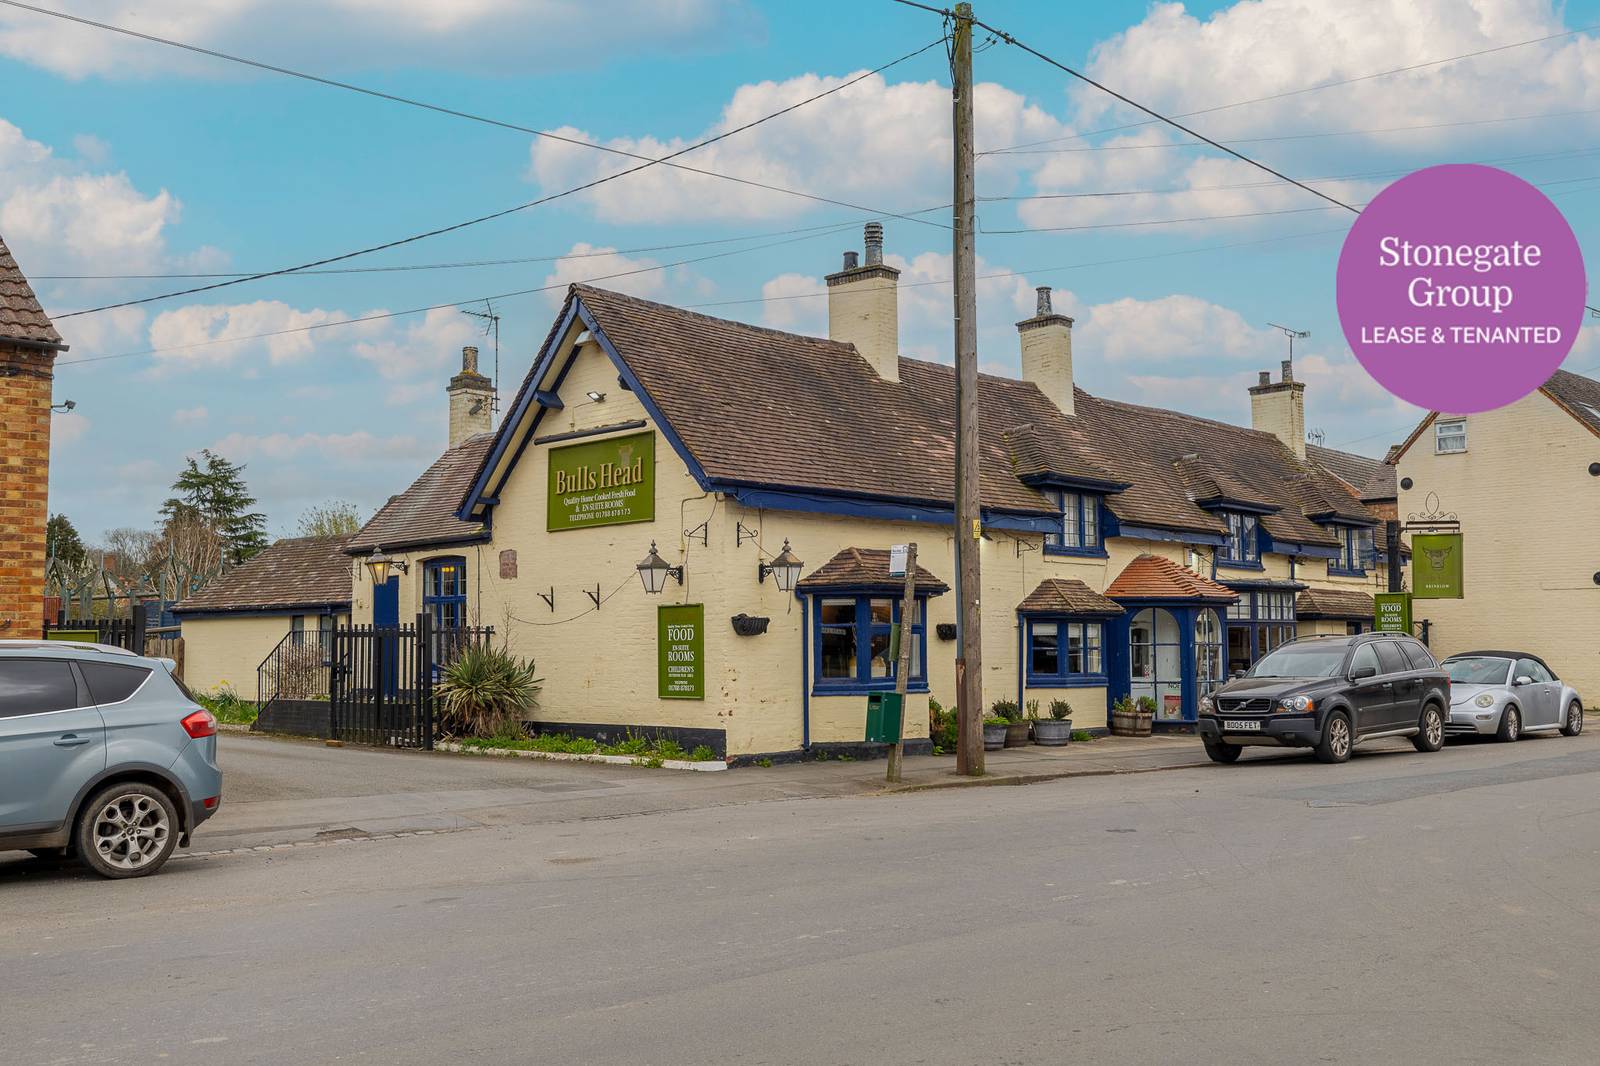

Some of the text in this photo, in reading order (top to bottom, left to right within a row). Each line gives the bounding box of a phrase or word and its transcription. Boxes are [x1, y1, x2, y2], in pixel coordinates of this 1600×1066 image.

[555, 457, 644, 495] Bulls Head
[563, 488, 636, 507] Quality Home Cooked Fresh Food
[604, 499, 624, 509] ROOMS
[667, 628, 694, 641] FOOD
[667, 651, 695, 662] ROOMS
